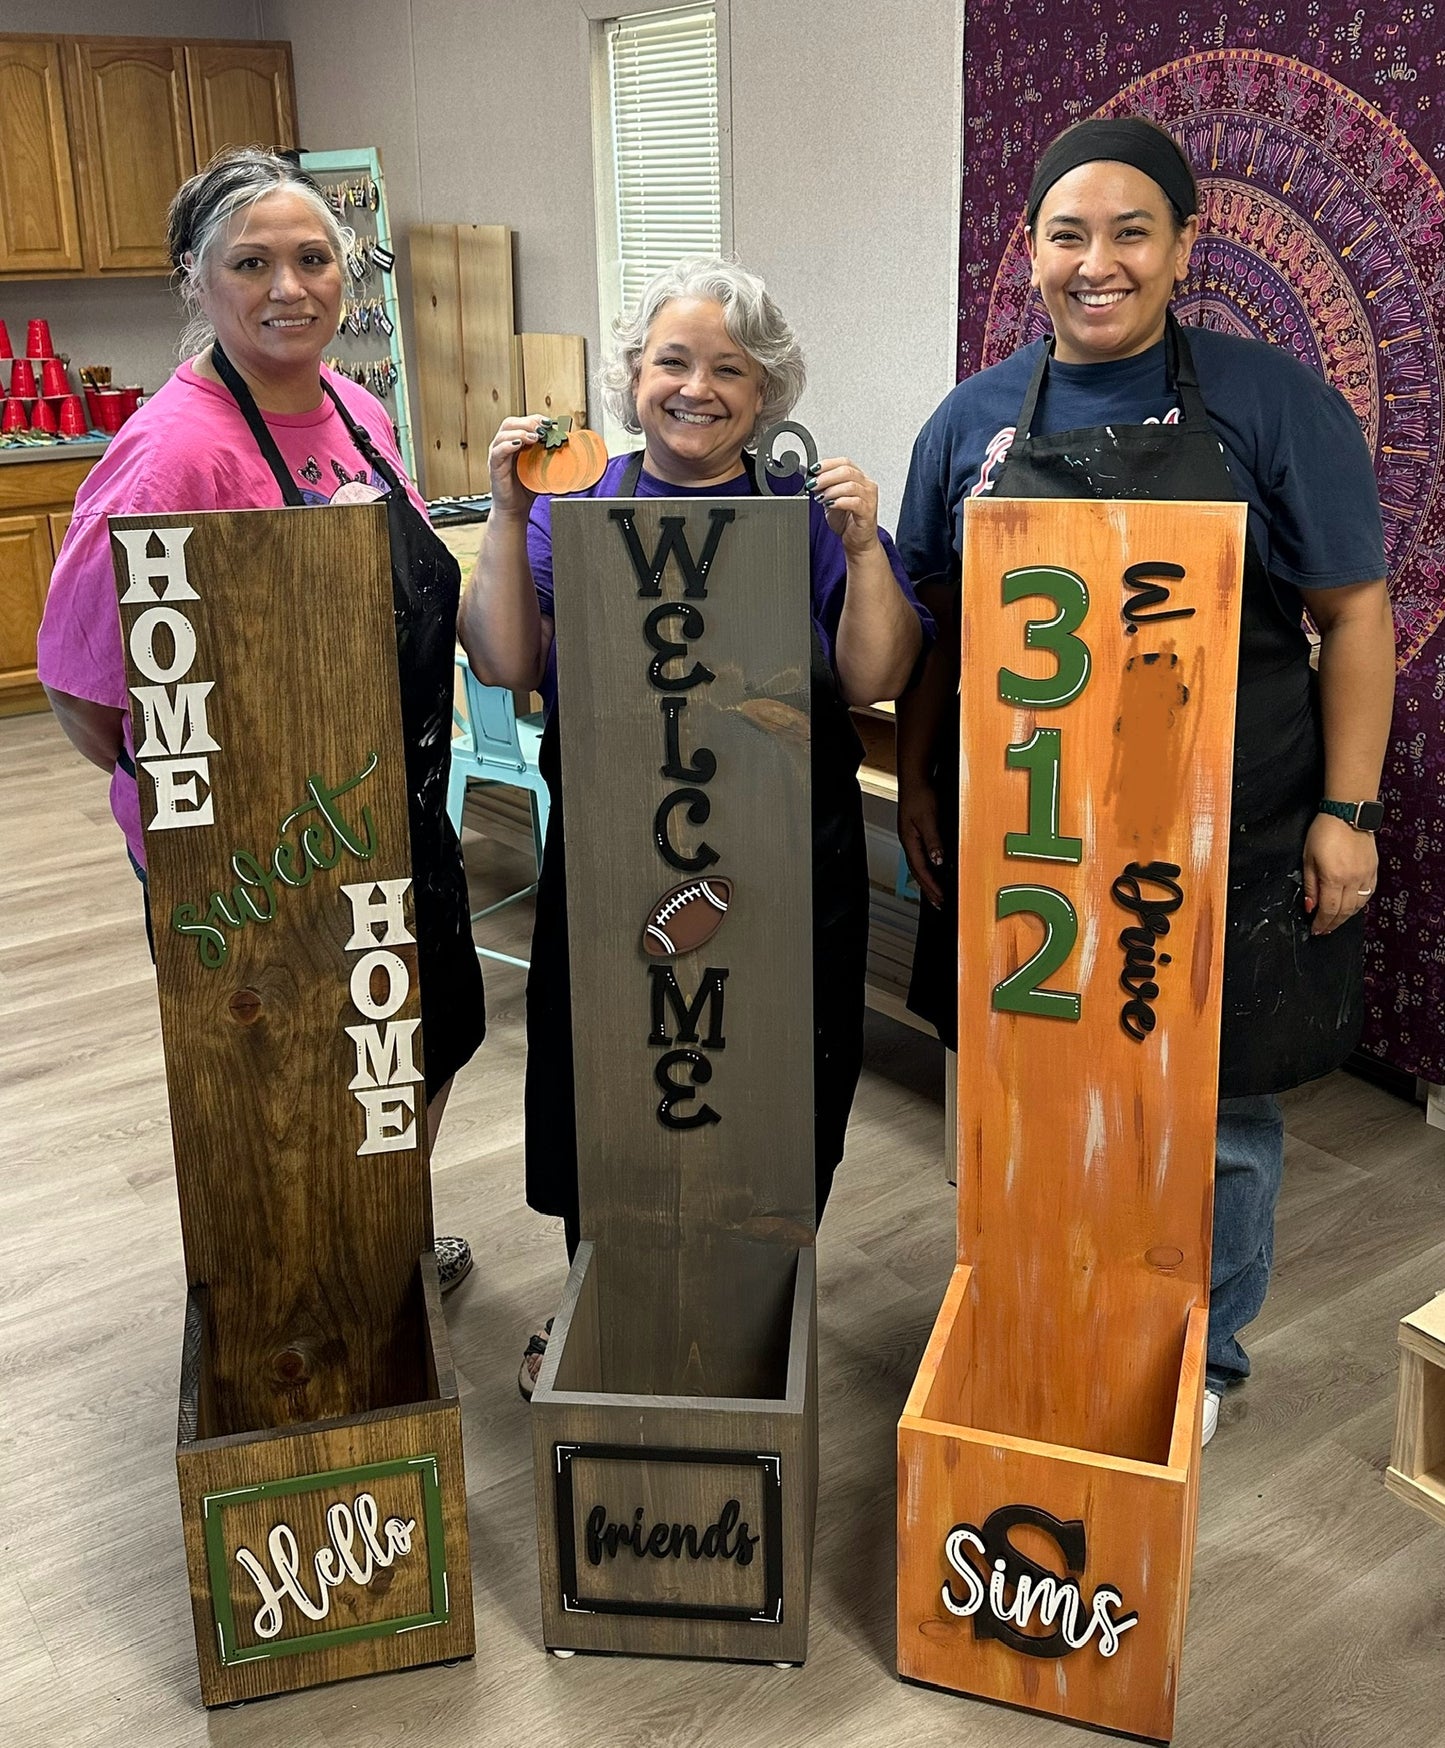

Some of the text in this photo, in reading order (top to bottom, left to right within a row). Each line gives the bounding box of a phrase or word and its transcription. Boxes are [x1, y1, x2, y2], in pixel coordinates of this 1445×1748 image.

[112, 526, 222, 832] HOME
[1123, 561, 1196, 633] W.
[172, 751, 379, 969] sweet
[610, 508, 735, 1131] WELCME
[994, 564, 1092, 1020] 312
[340, 878, 425, 1156] HOME
[1112, 861, 1184, 1042] Drive
[236, 1492, 416, 1639] Hello
[585, 1499, 761, 1567] friends
[942, 1523, 1138, 1658] Sims
